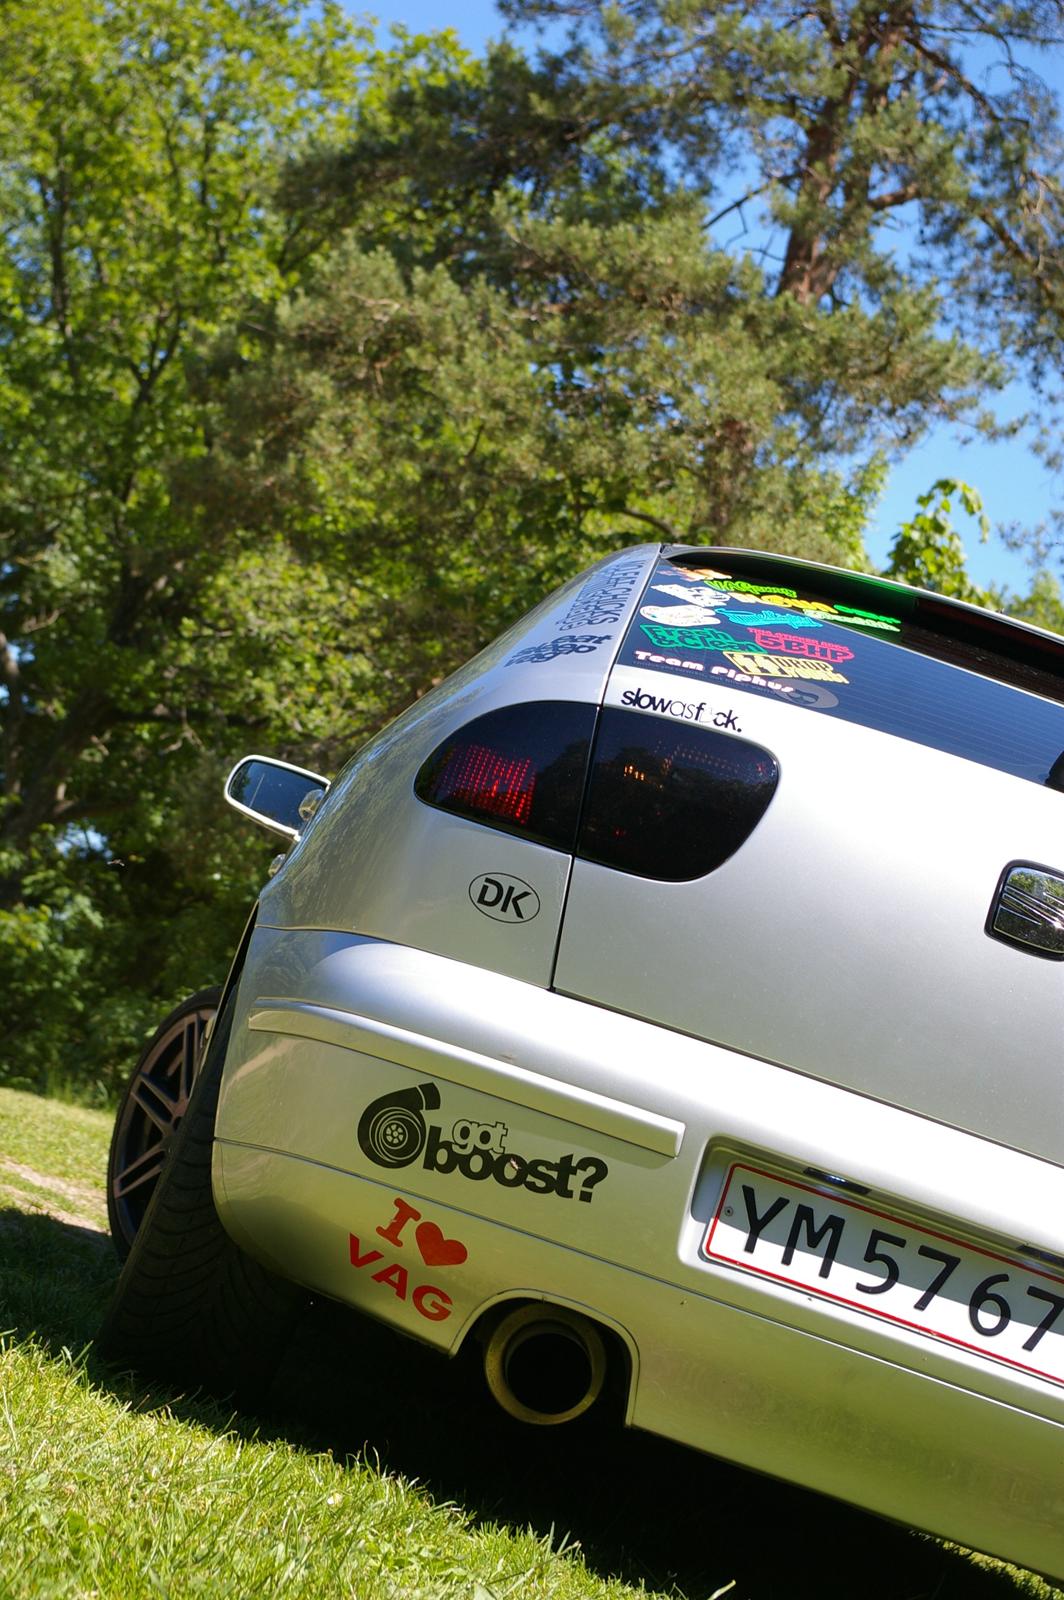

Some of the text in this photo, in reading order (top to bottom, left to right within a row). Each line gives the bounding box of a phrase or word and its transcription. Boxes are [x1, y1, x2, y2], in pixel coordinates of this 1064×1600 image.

[587, 587, 633, 625] CHICKS
[641, 625, 734, 644] Fresh
[676, 635, 767, 653] Clean
[757, 633, 854, 662] 5BHP
[634, 650, 705, 672] Team
[620, 687, 743, 733] slowasfck.
[477, 877, 532, 919] DK
[451, 1118, 508, 1155] got
[422, 1124, 609, 1203] boost?
[375, 1197, 422, 1248] I
[349, 1232, 454, 1322] VAG
